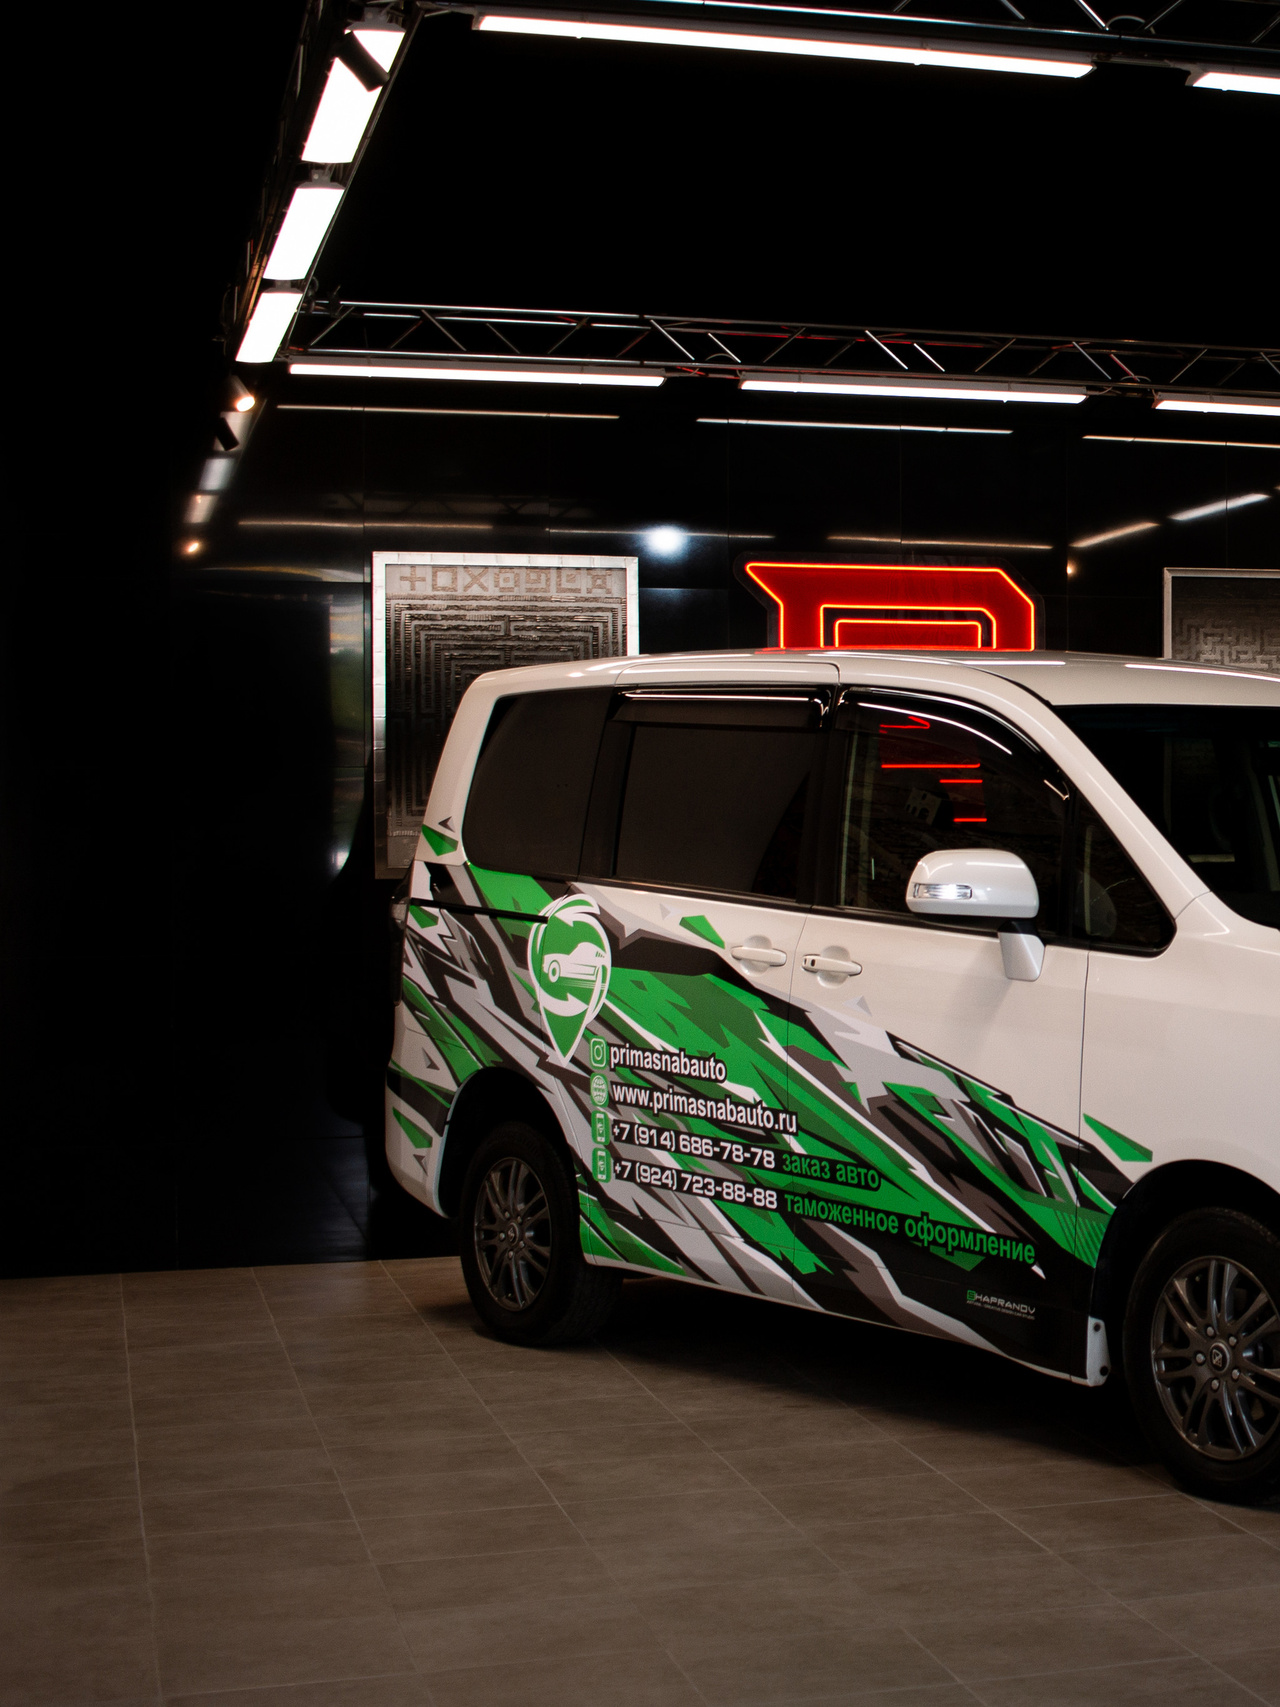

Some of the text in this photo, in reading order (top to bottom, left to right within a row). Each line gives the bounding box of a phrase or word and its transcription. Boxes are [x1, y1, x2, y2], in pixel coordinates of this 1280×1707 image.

[610, 1043, 726, 1081] primasnabauto
[613, 1084, 797, 1133] www.primasnabauto.ru
[613, 1123, 879, 1188] +7 (914) 686-78-78 заказ авто
[615, 1161, 1035, 1265] +7 (924) 723-88-88 таможенное оформление
